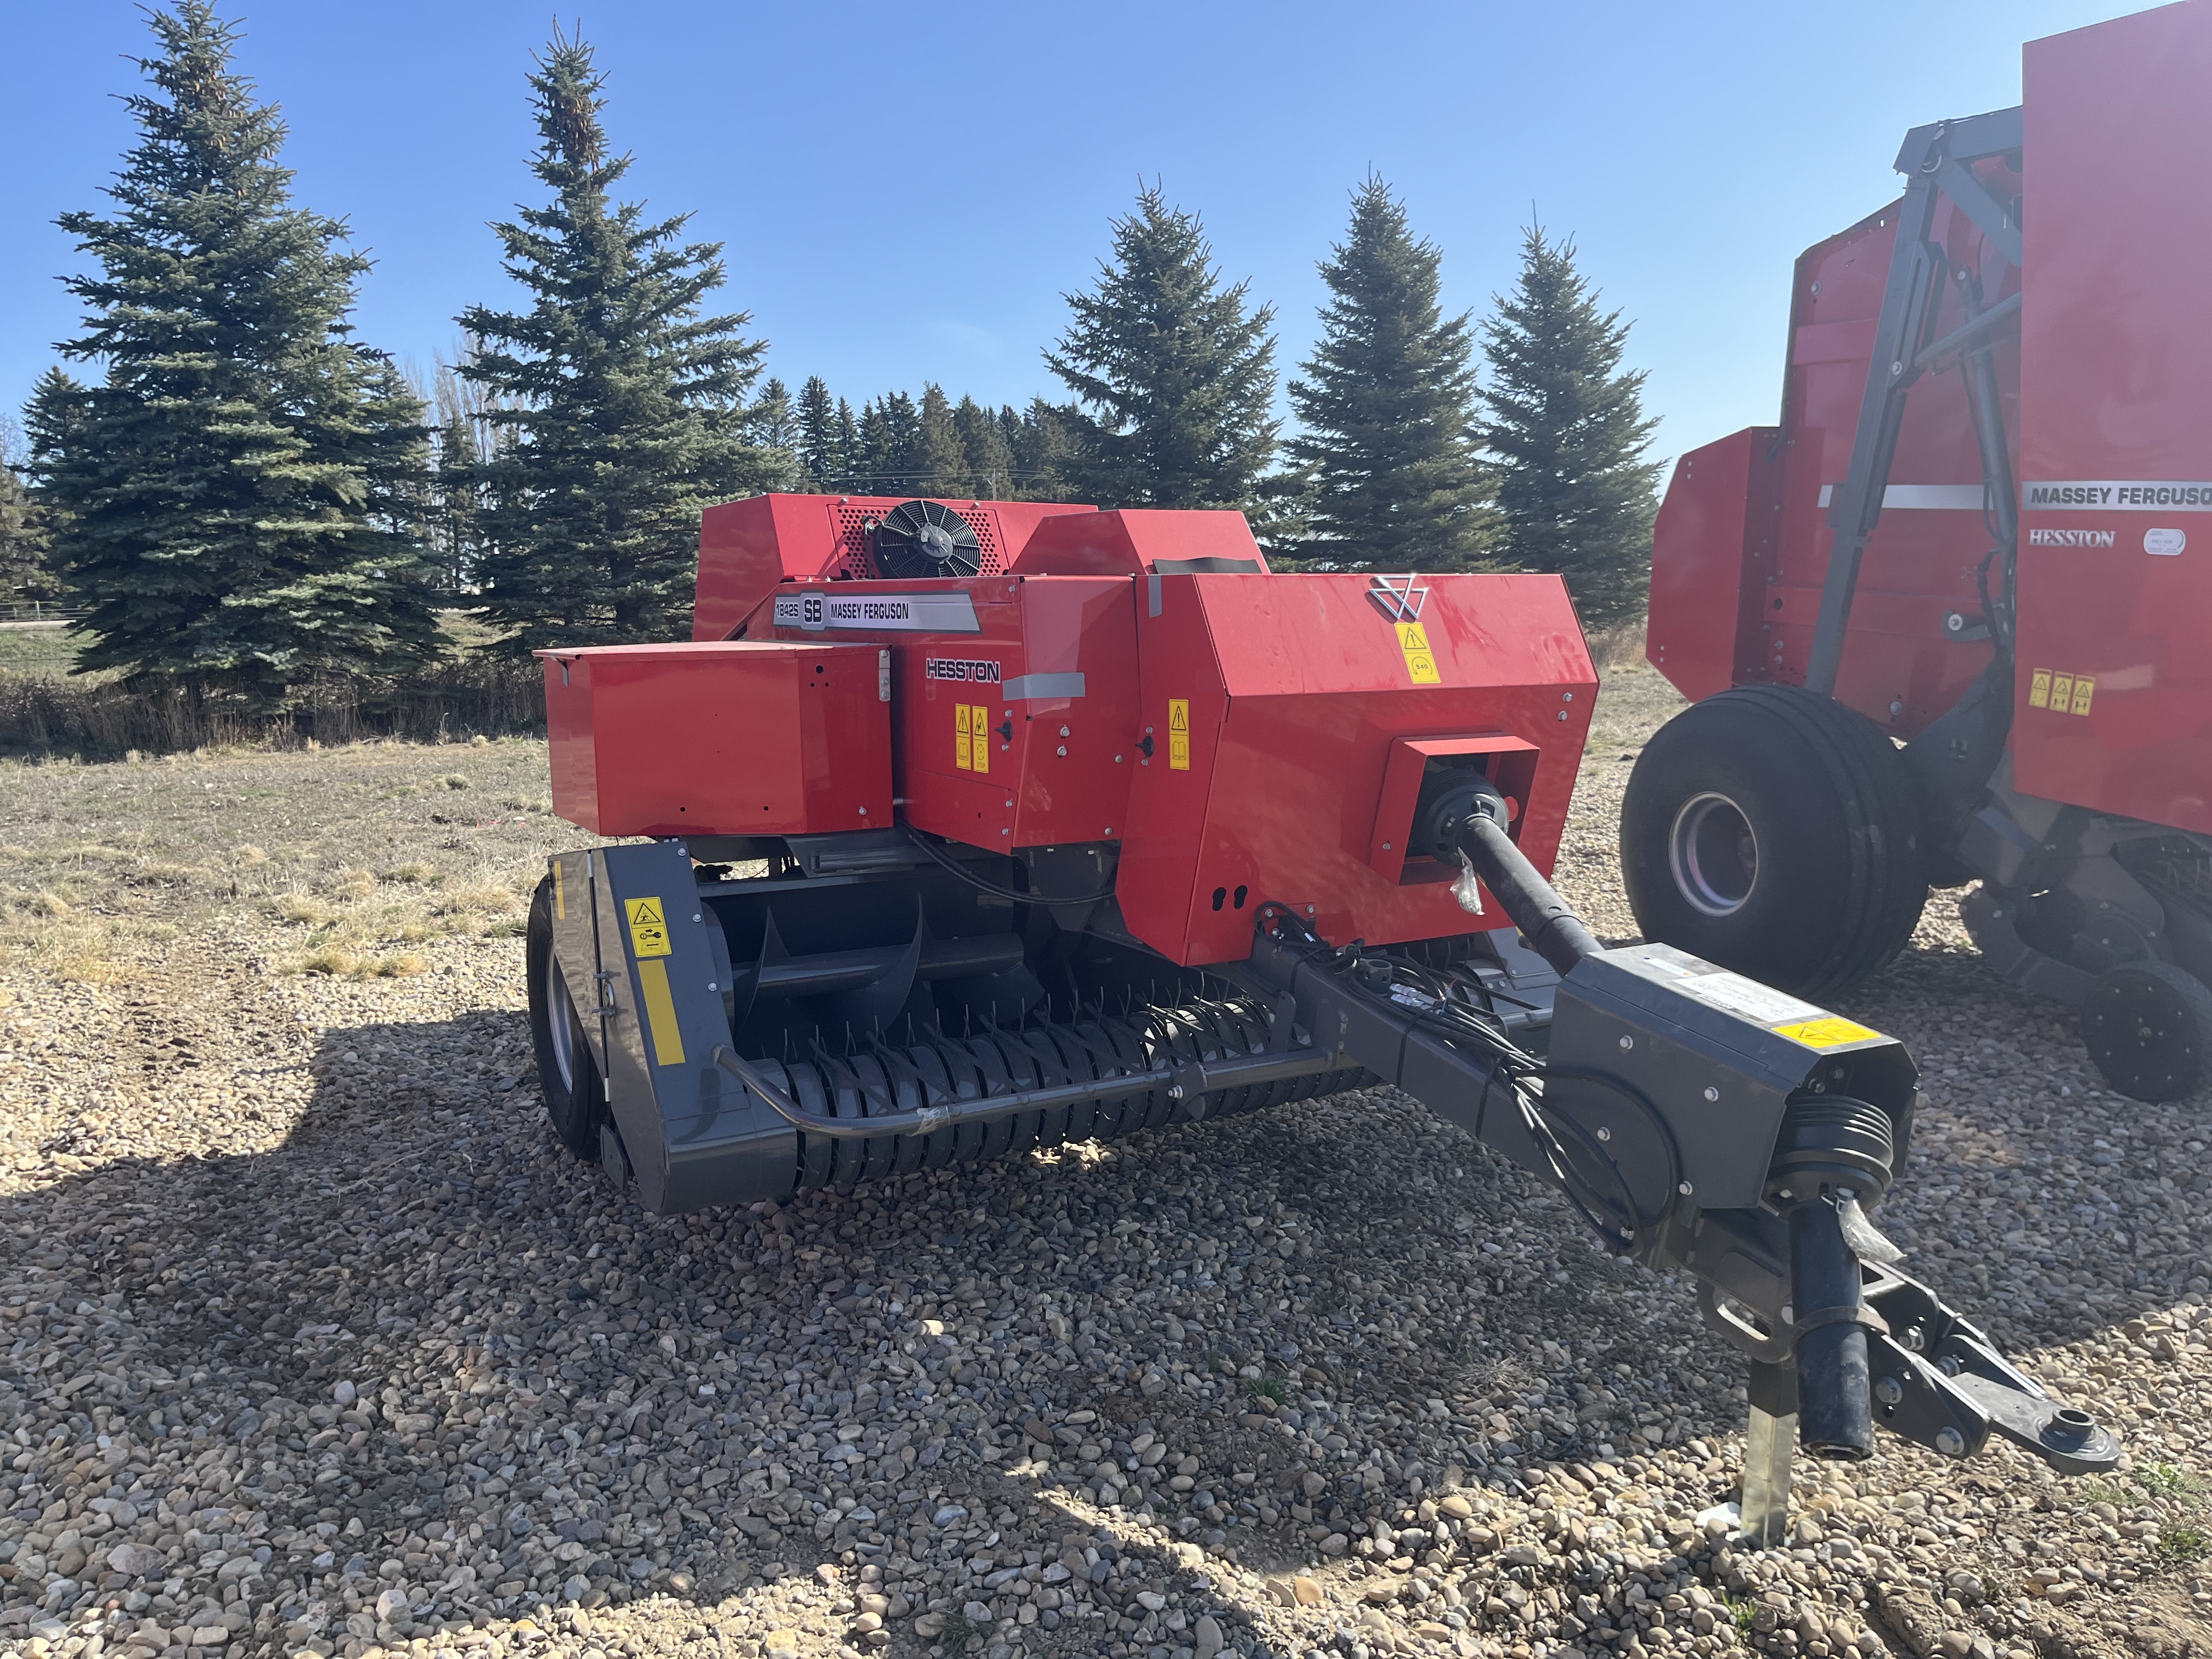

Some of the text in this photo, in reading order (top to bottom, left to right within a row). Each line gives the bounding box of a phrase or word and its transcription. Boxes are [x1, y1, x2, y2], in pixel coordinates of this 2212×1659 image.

[2032, 487, 2112, 504] MASSEY
[2028, 529, 2116, 548] HESSTON
[776, 599, 909, 623] 1842S SB MASSEY FERGUSON
[927, 659, 1000, 682] HESSTON
[1695, 993, 1734, 1009] NOTICE
